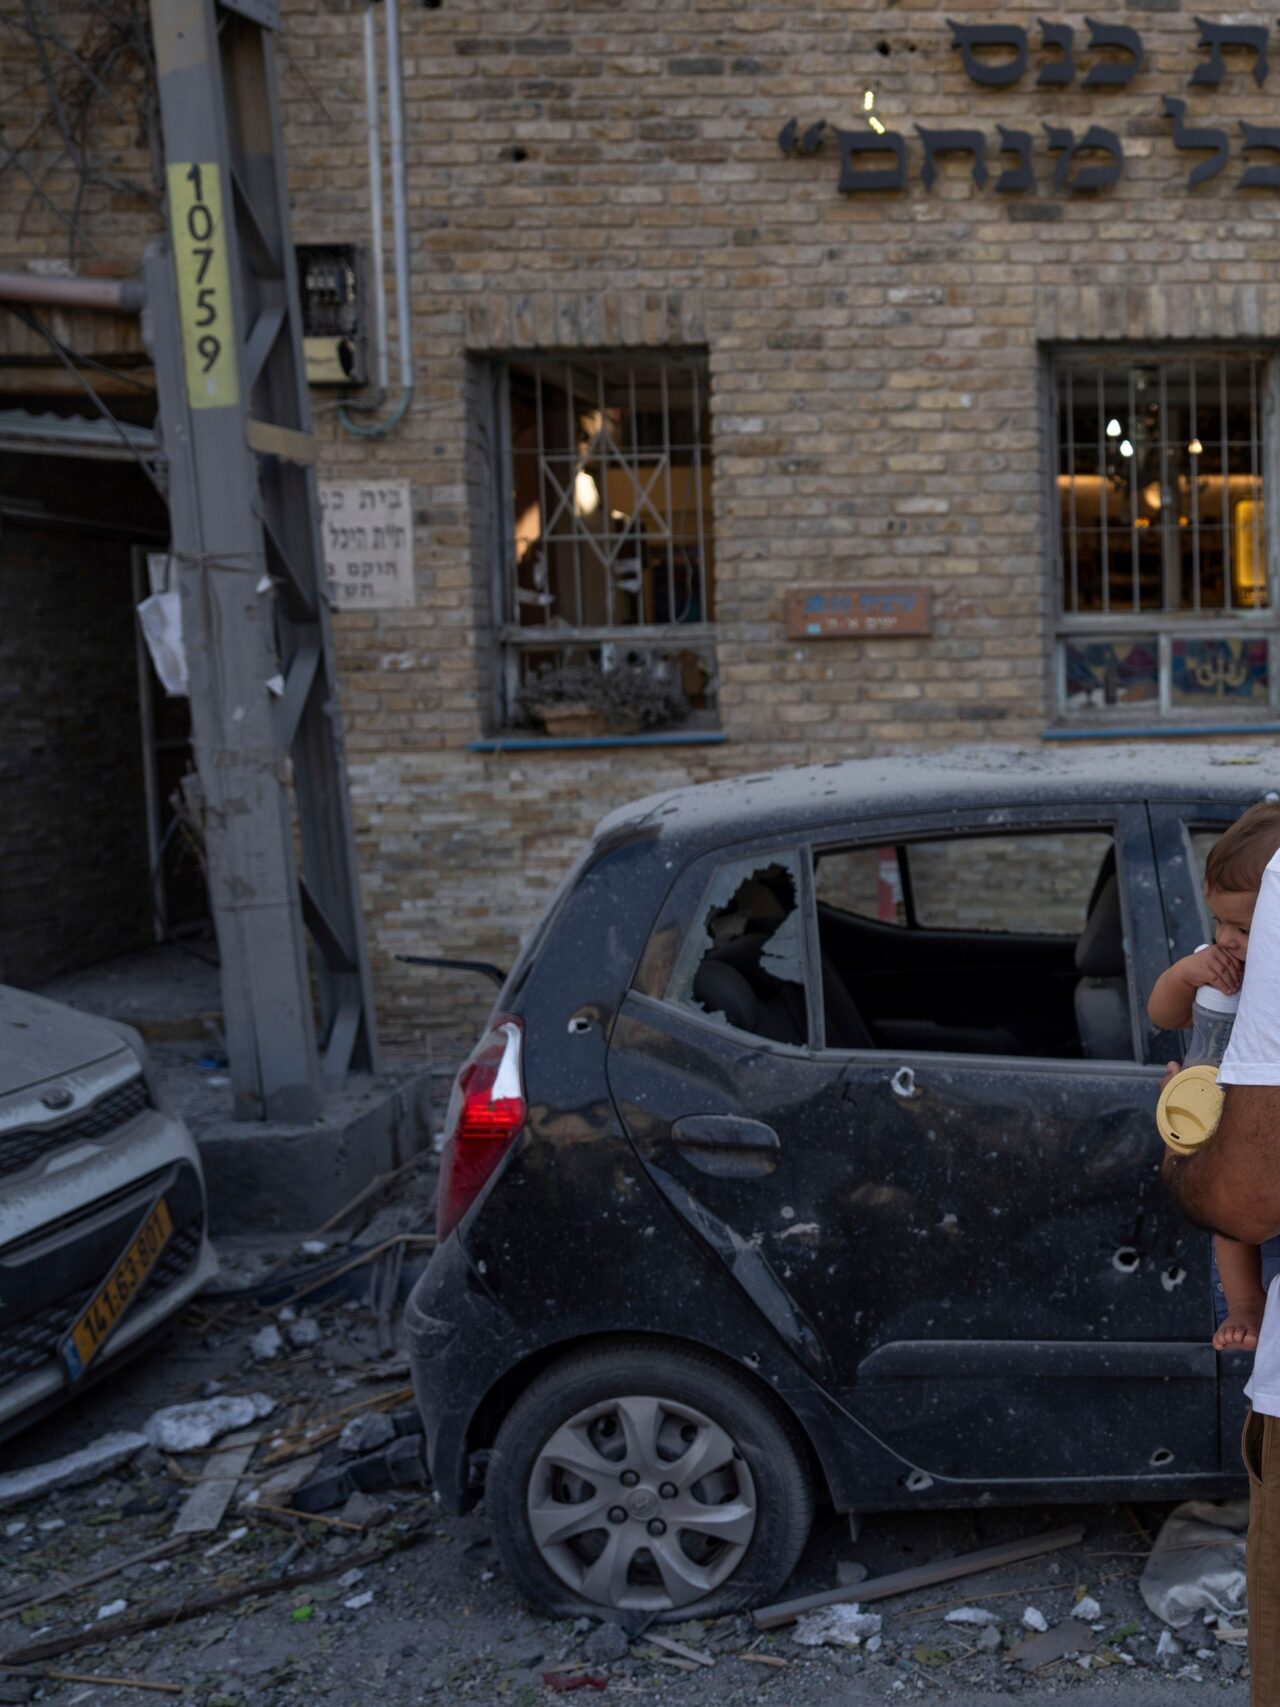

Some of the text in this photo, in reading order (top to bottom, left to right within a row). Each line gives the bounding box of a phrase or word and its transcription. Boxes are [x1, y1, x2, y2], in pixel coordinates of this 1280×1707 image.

[946, 16, 1144, 88] כנס
[186, 163, 221, 374] 10759
[359, 489, 402, 509] בית
